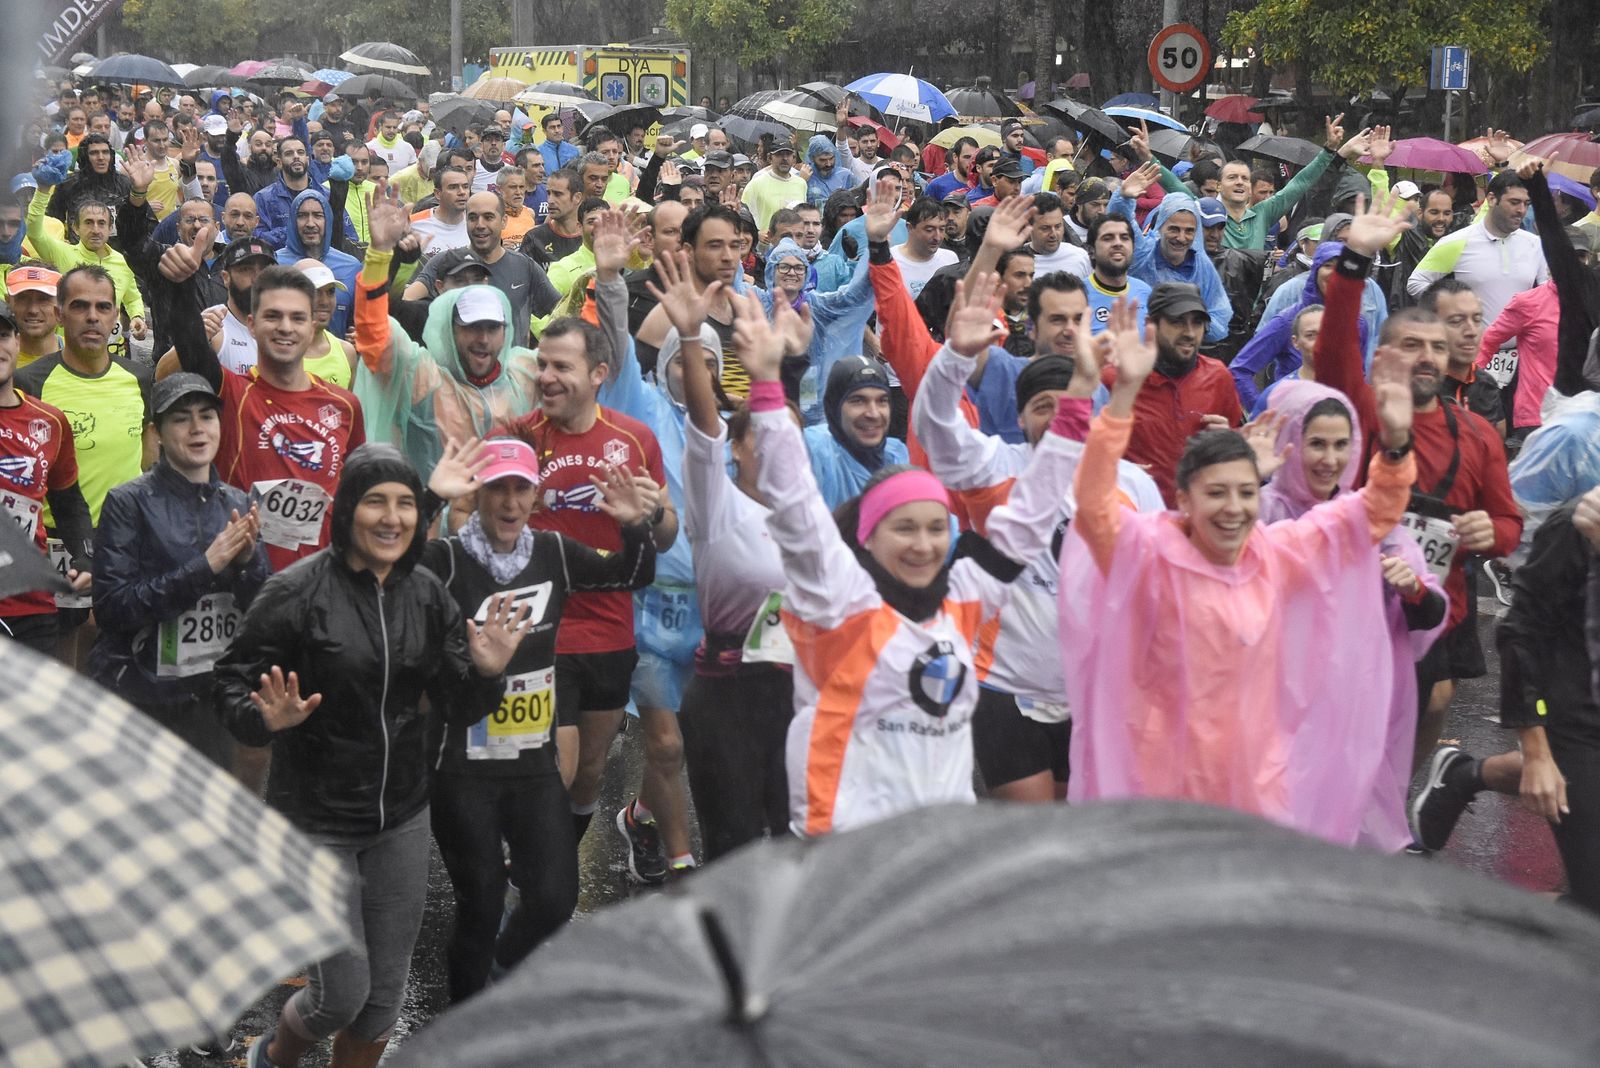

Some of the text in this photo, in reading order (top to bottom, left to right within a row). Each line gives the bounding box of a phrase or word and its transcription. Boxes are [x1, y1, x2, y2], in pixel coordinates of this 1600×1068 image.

[36, 0, 102, 58] IMDE
[619, 59, 651, 73] DYA
[1162, 46, 1198, 69] 50
[266, 490, 325, 522] 6032
[181, 611, 238, 644] 2866
[492, 689, 551, 725] 6601
[877, 718, 905, 733] San
